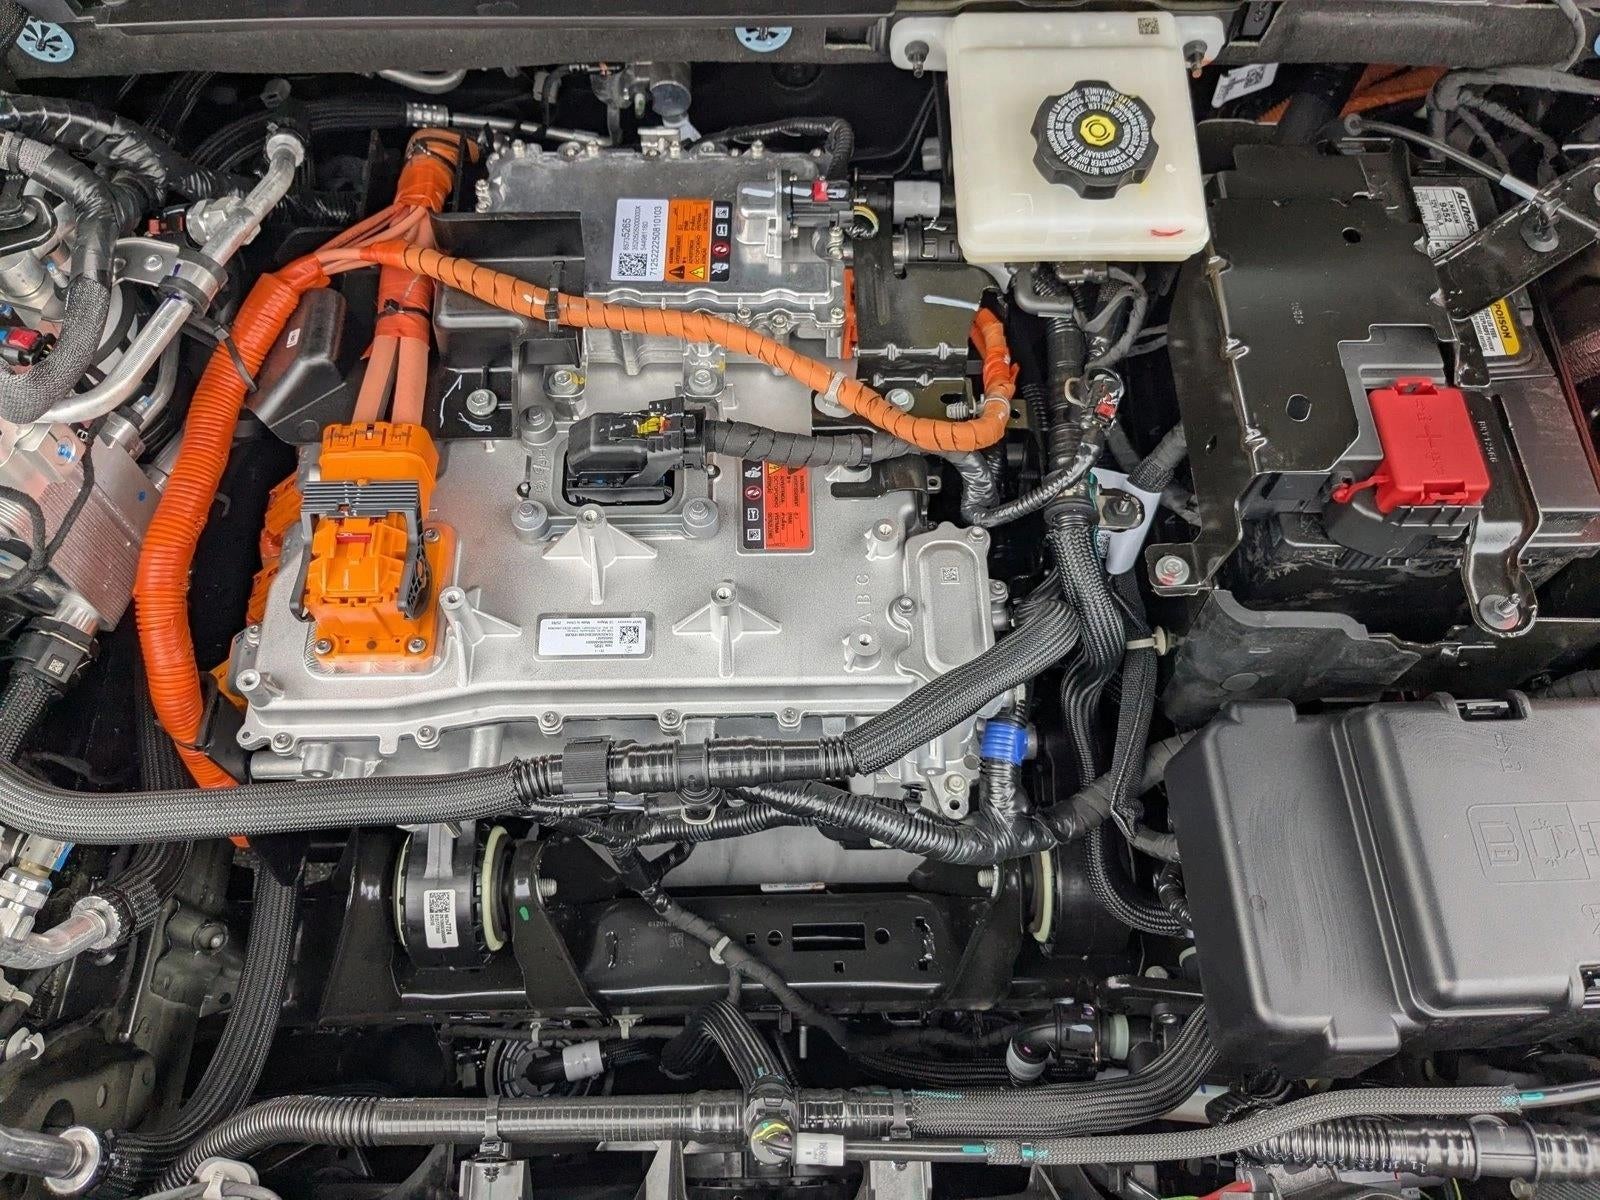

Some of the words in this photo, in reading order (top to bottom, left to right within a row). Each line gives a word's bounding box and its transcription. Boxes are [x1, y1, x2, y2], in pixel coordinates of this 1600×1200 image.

[1083, 147, 1120, 157] PROVENANT
[1075, 154, 1089, 164] QUE
[1066, 159, 1099, 174] NETTOYER
[1440, 202, 1452, 223] 9352
[1494, 304, 1512, 338] POISON
[856, 574, 870, 585] C
[857, 595, 870, 604] B
